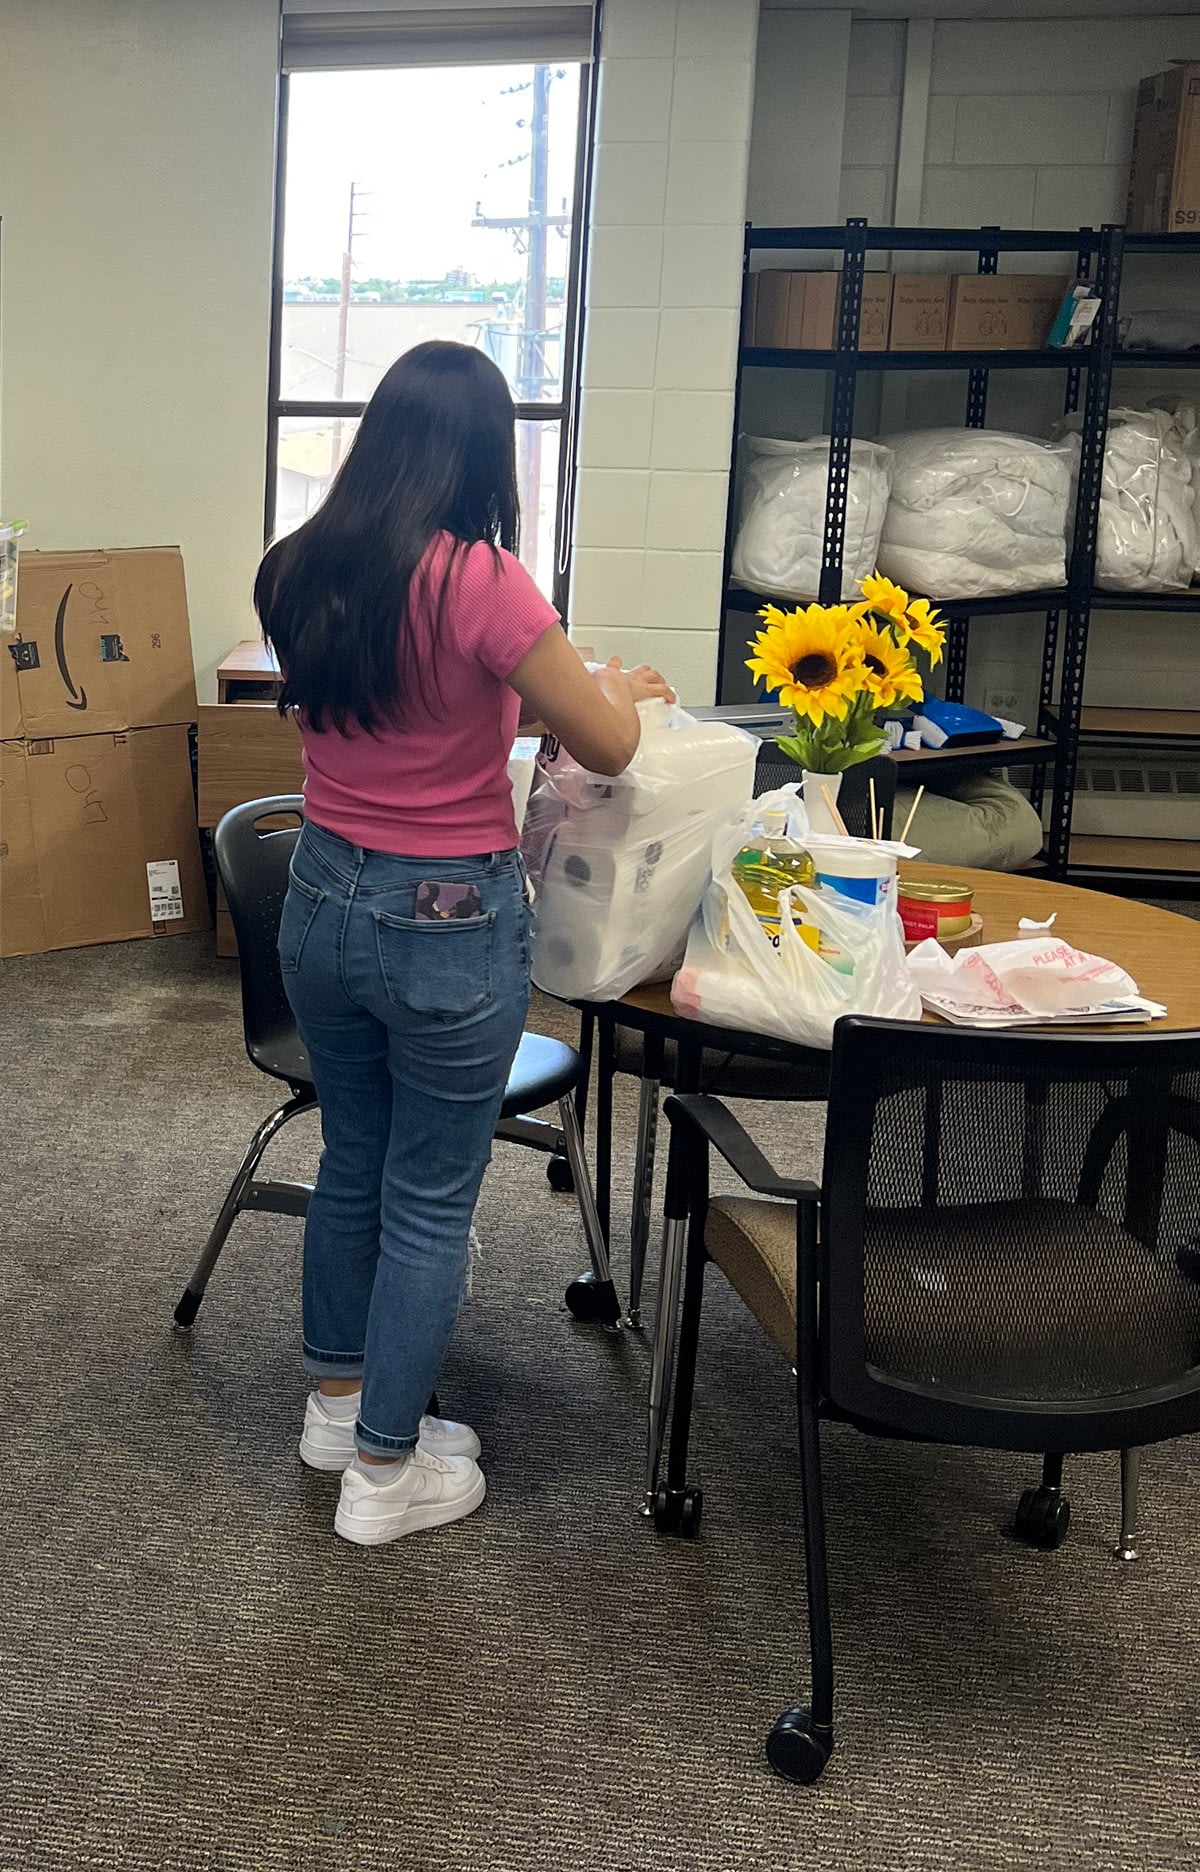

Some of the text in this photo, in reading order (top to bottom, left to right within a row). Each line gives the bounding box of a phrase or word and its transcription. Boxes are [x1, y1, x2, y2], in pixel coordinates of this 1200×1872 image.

[152, 633, 162, 649] 296
[1032, 945, 1071, 966] PLEASE
[1064, 955, 1075, 968] AT
